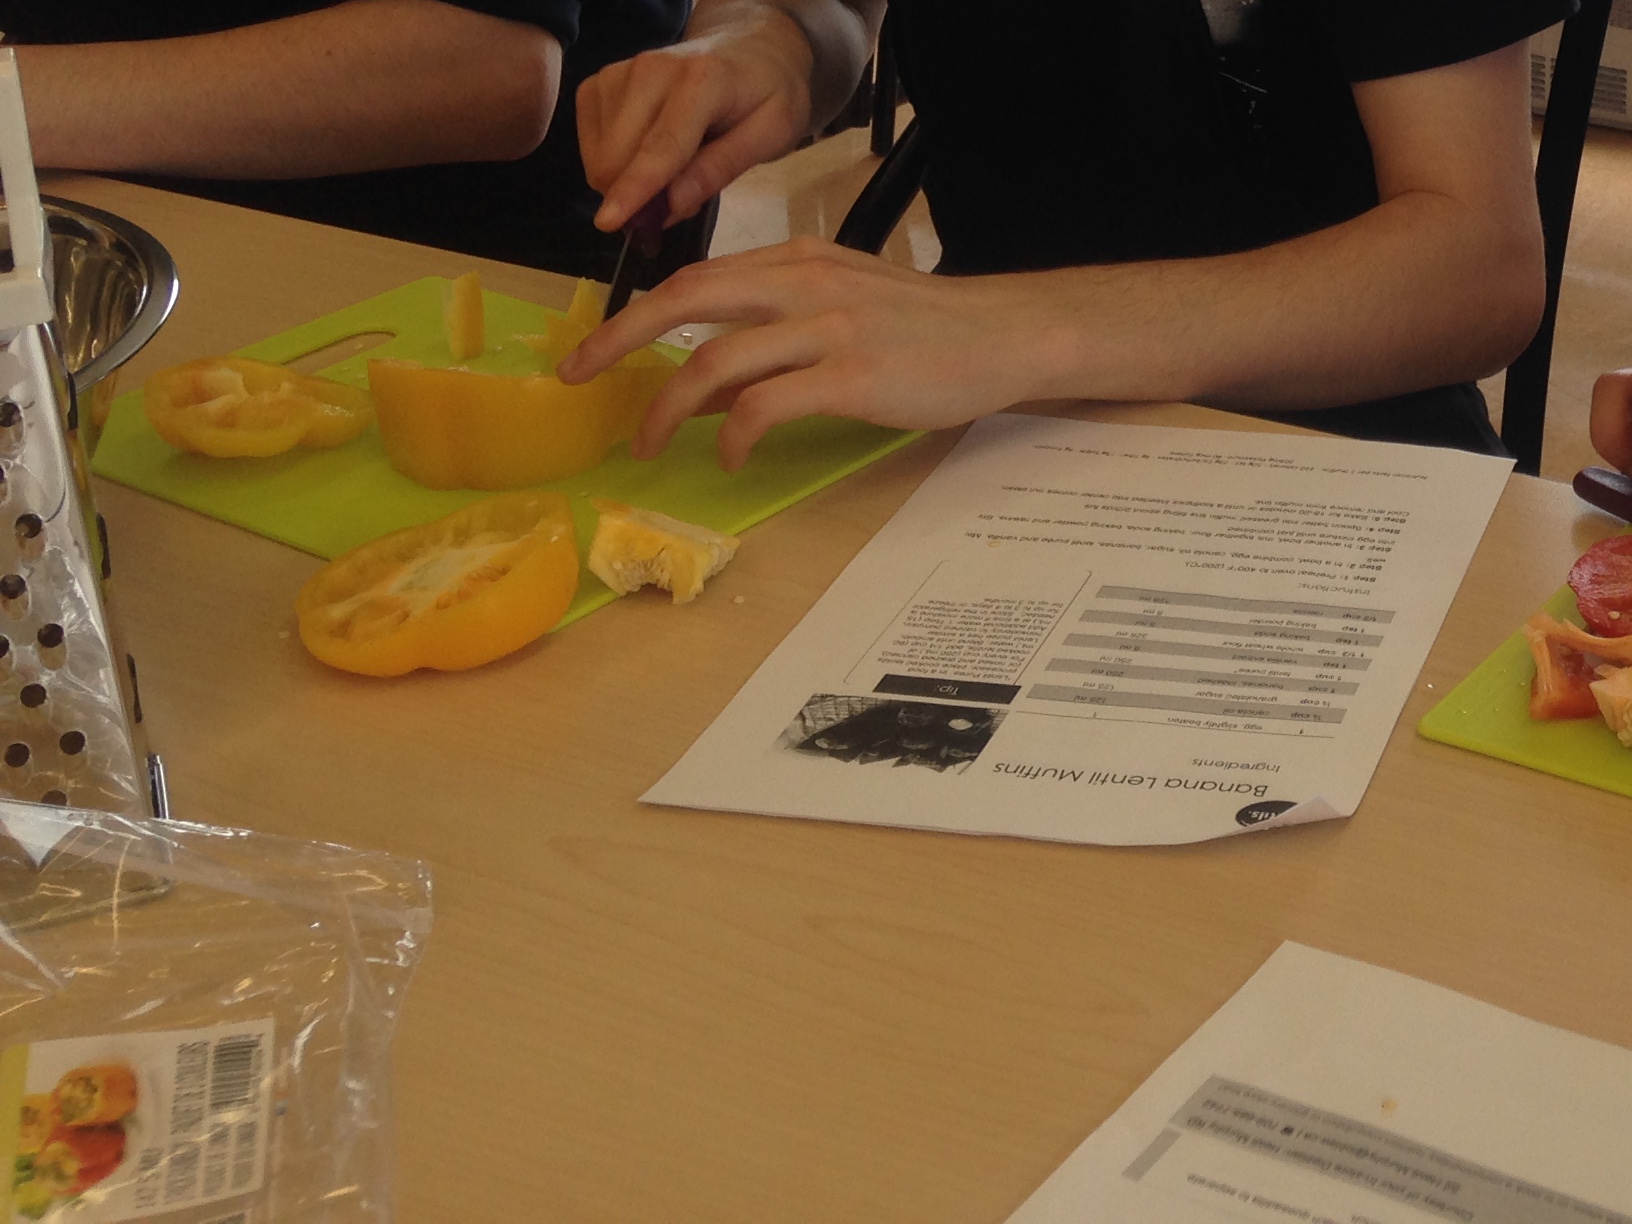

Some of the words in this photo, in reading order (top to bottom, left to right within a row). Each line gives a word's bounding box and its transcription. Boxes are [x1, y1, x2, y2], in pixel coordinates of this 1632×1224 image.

[990, 763, 1085, 782] Muffins
[1190, 758, 1281, 772] Ingredients
[1088, 771, 1158, 789] Lentil
[1163, 779, 1268, 797] Banana
